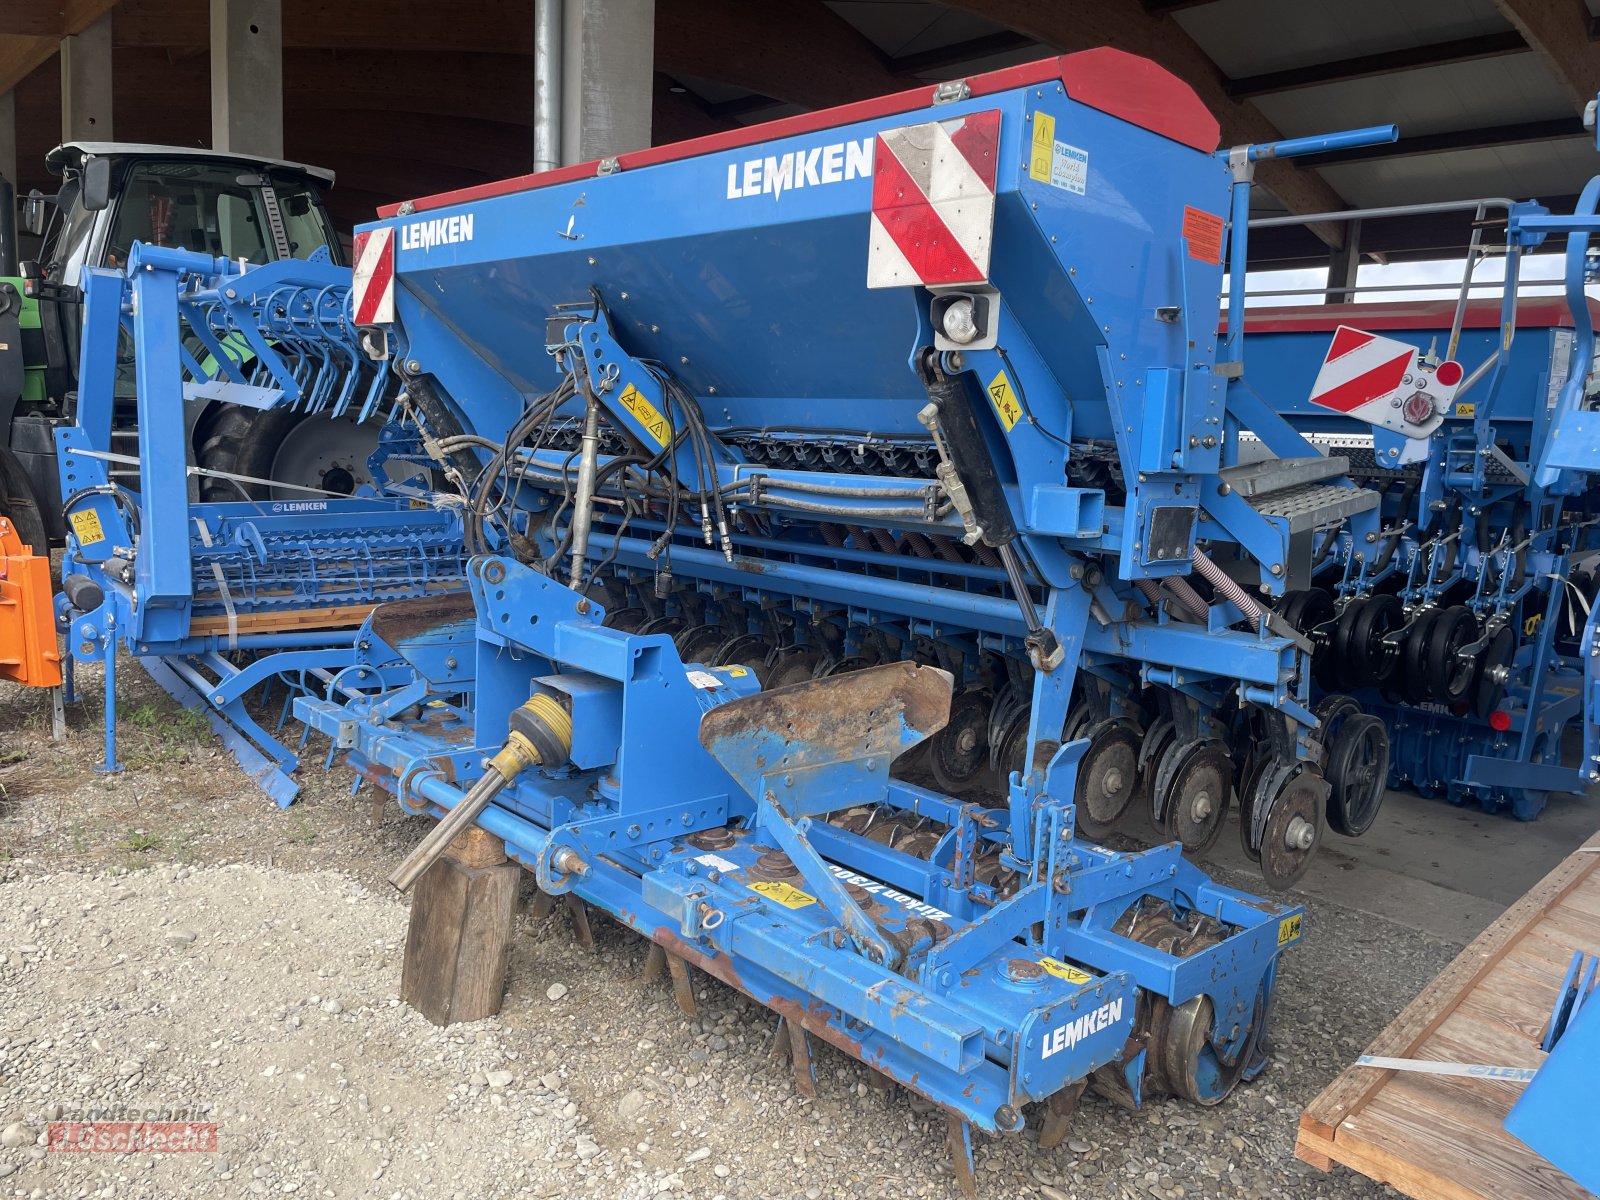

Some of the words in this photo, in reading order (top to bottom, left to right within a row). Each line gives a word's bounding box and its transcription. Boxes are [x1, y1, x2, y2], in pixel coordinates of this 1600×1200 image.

[726, 137, 874, 202] LEMKEN
[1061, 147, 1087, 164] LEMKEN
[401, 213, 474, 254] LEMKEN
[283, 502, 327, 512] LEMKEN
[882, 889, 953, 921] Zirkon
[1041, 997, 1123, 1060] LEMKEN
